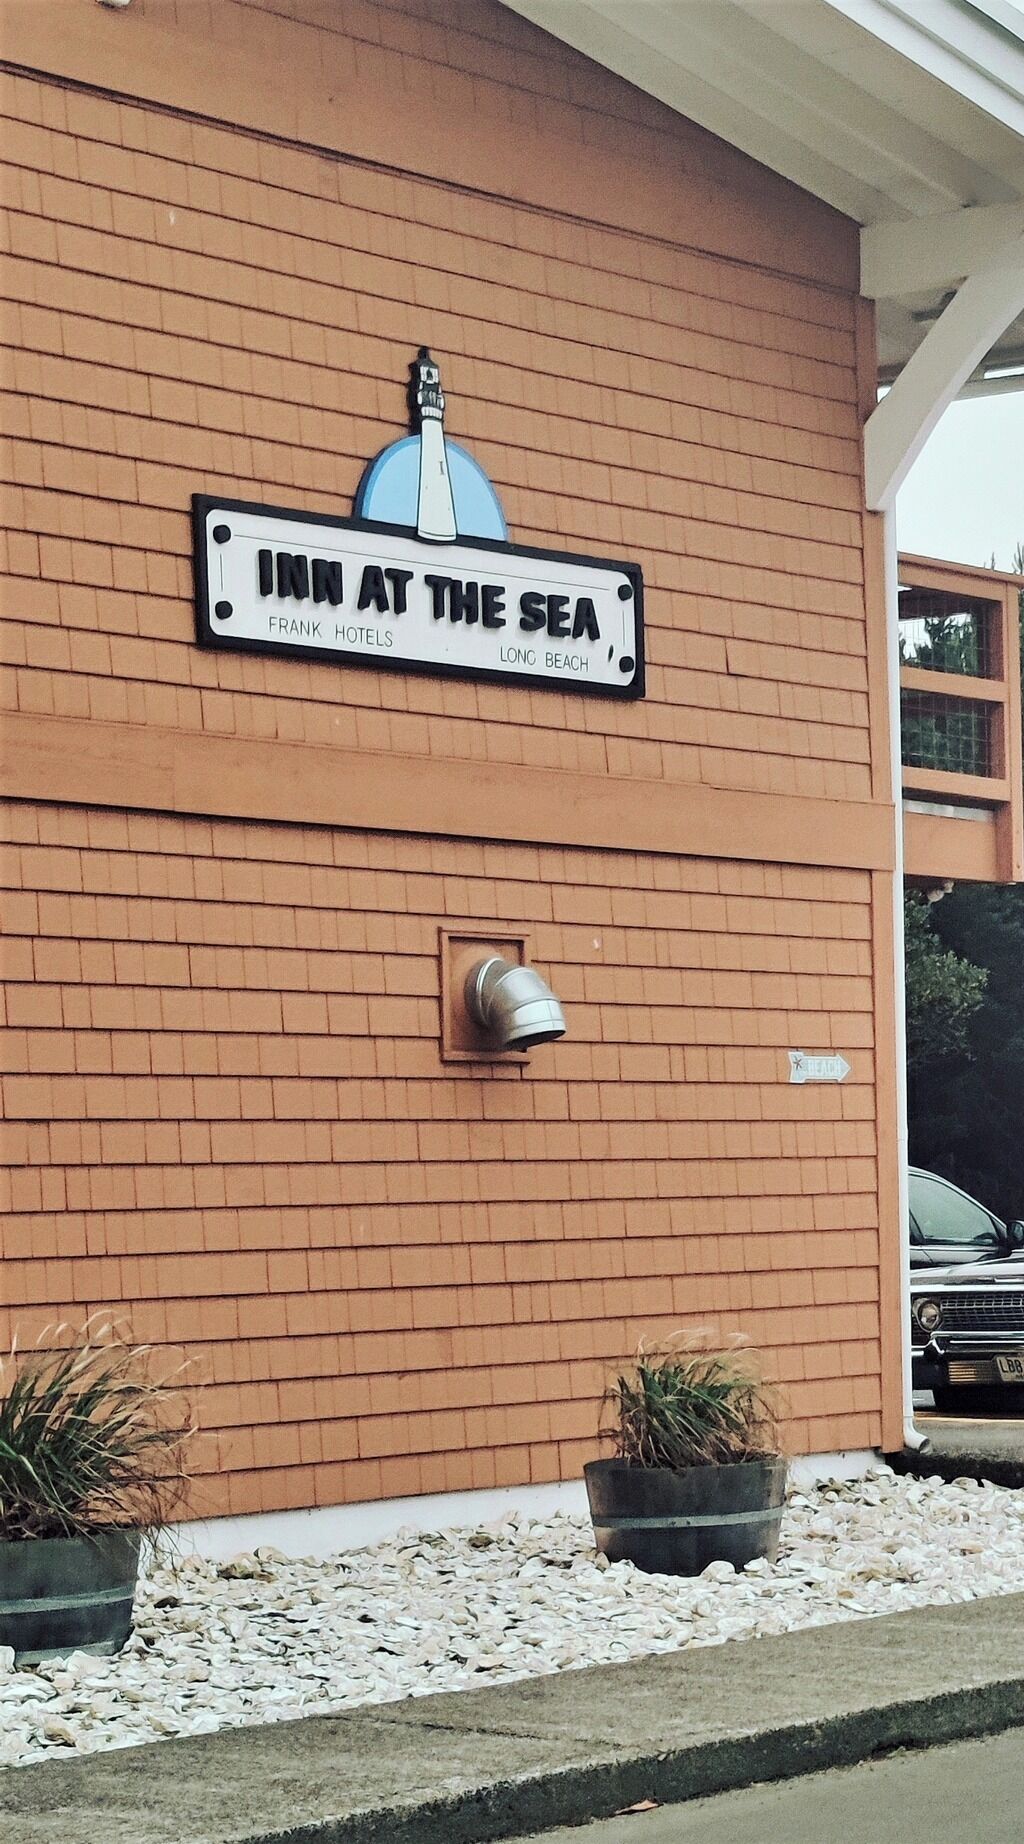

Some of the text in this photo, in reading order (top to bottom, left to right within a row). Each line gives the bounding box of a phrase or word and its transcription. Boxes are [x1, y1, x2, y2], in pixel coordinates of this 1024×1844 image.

[258, 548, 601, 642] INN AT THE SEA
[268, 615, 394, 648] FRANK HOTELS
[499, 645, 589, 673] LONG BEACH
